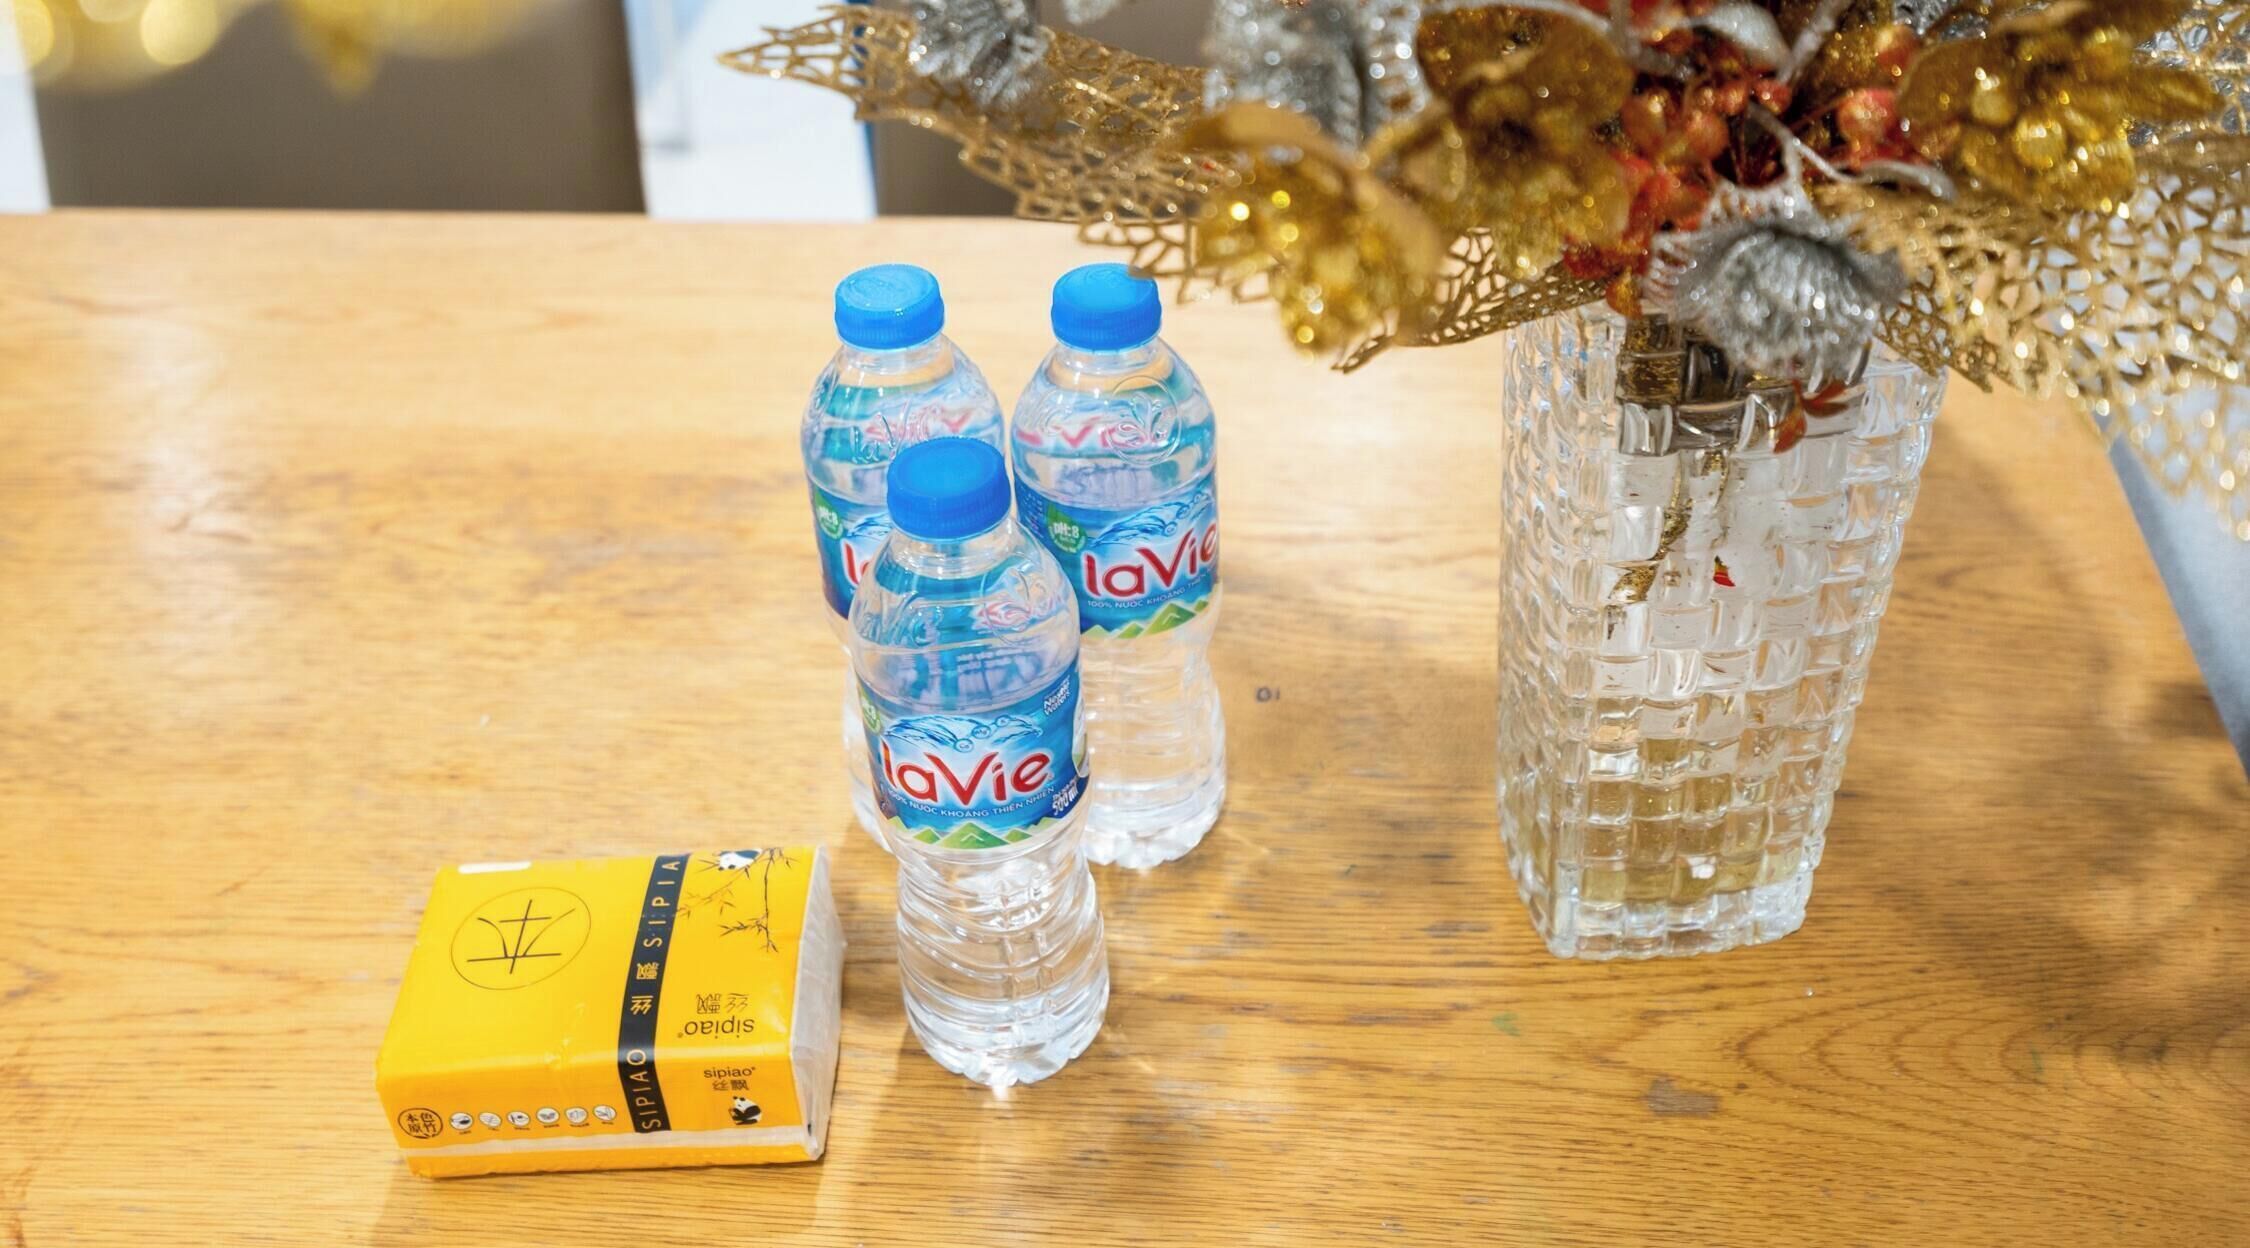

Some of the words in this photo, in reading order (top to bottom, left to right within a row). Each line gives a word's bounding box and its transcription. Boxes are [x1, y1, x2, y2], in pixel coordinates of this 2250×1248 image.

[1085, 523, 1217, 598] laVie
[881, 740, 1050, 807] laVie
[626, 1048, 662, 1130] SIPIAO
[703, 1067, 753, 1080] sipiao
